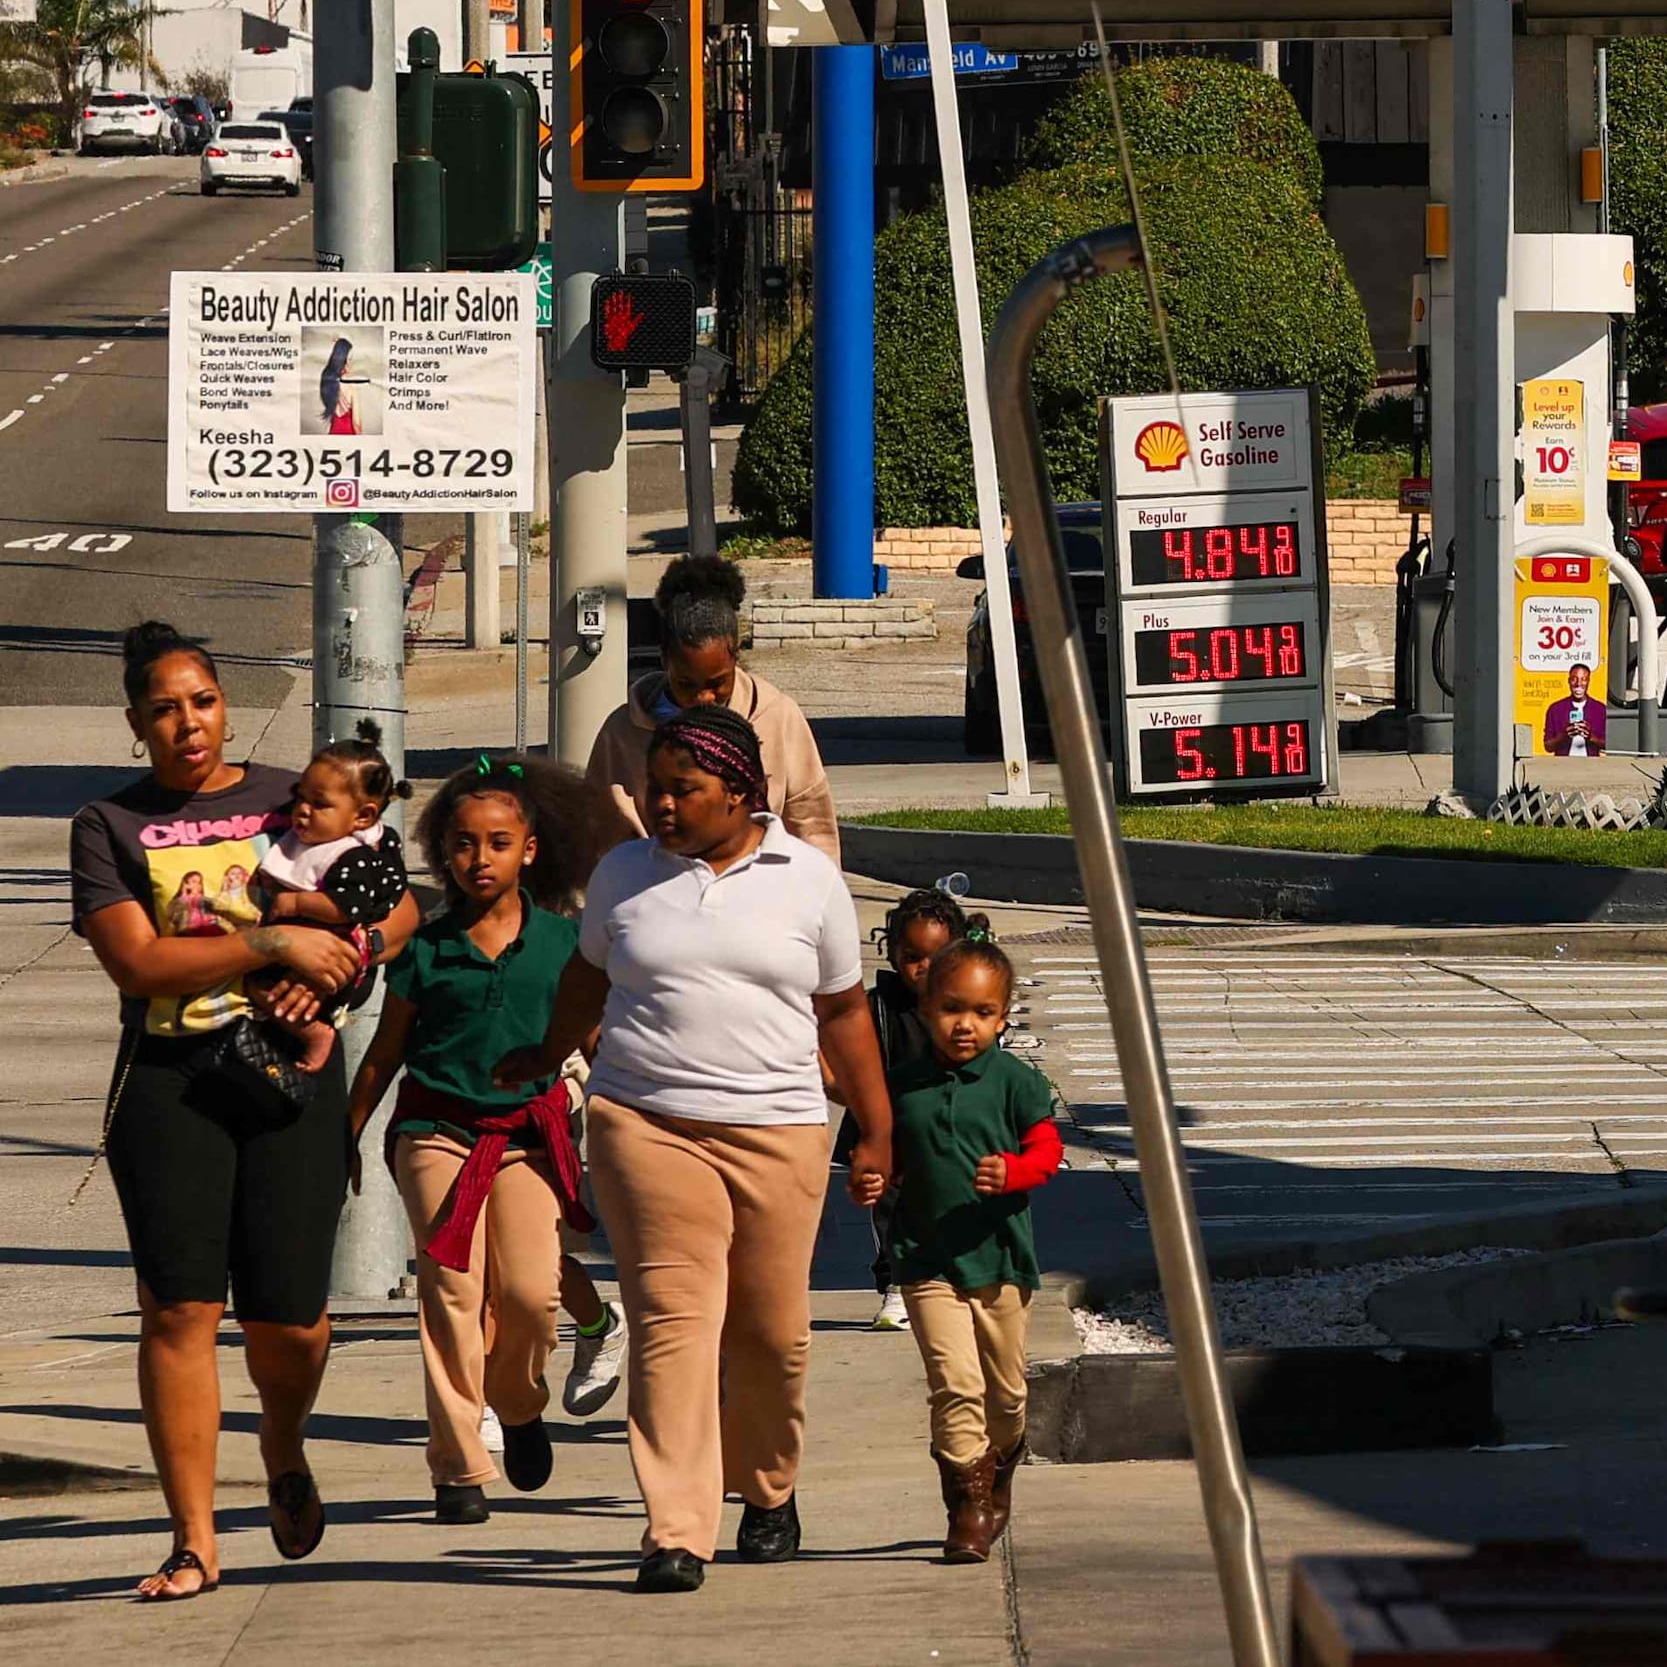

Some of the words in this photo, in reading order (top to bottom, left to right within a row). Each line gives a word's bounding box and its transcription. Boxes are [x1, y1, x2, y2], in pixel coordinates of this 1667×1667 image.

[892, 48, 974, 74] Maneld
[201, 287, 279, 331] Beauty
[286, 287, 394, 322] Addiction
[403, 287, 449, 322] Hair
[456, 286, 518, 322] Salon
[201, 334, 236, 343] Weave
[239, 334, 291, 343] Extension
[389, 331, 423, 341] Press
[426, 331, 434, 341] &
[201, 348, 226, 357] Lace
[229, 348, 299, 359] Weaves/Wigs
[389, 345, 453, 355] Permanent
[456, 345, 488, 355] Wave
[200, 361, 294, 371] Frontals/Closures
[389, 359, 440, 369] Relaxers
[200, 374, 231, 384] Quick
[236, 374, 274, 383] Weaves
[389, 373, 413, 383] Hair
[416, 373, 448, 383] Color
[200, 387, 228, 397] Bond
[232, 387, 272, 397] Weaves
[389, 387, 431, 399] Crimps
[200, 400, 249, 411] Ponytails
[389, 401, 412, 411] And
[416, 401, 449, 411] More!
[1534, 402, 1559, 412] Level
[1561, 404, 1574, 413] up
[1542, 413, 1565, 421] your
[1533, 420, 1576, 430] Rewards
[200, 429, 274, 445] Keesha
[1199, 421, 1232, 442] Self
[1238, 421, 1285, 440] Serve
[1200, 445, 1279, 467] Gasoline
[208, 448, 513, 485] (323)514-8729
[190, 489, 226, 499] Follow
[230, 491, 242, 499] us
[246, 491, 260, 499] on
[264, 489, 317, 501] Instagram
[1138, 508, 1187, 527] Regular
[1529, 605, 1550, 614] New
[1552, 605, 1593, 614] Members
[1143, 614, 1169, 628] Plus
[1537, 616, 1553, 624] Join
[1529, 653, 1541, 661] on
[1542, 653, 1562, 663] your
[1565, 652, 1579, 661] 3rd
[1581, 652, 1591, 661] fill
[1150, 712, 1202, 727] V-Power
[139, 811, 275, 848] Cluele
